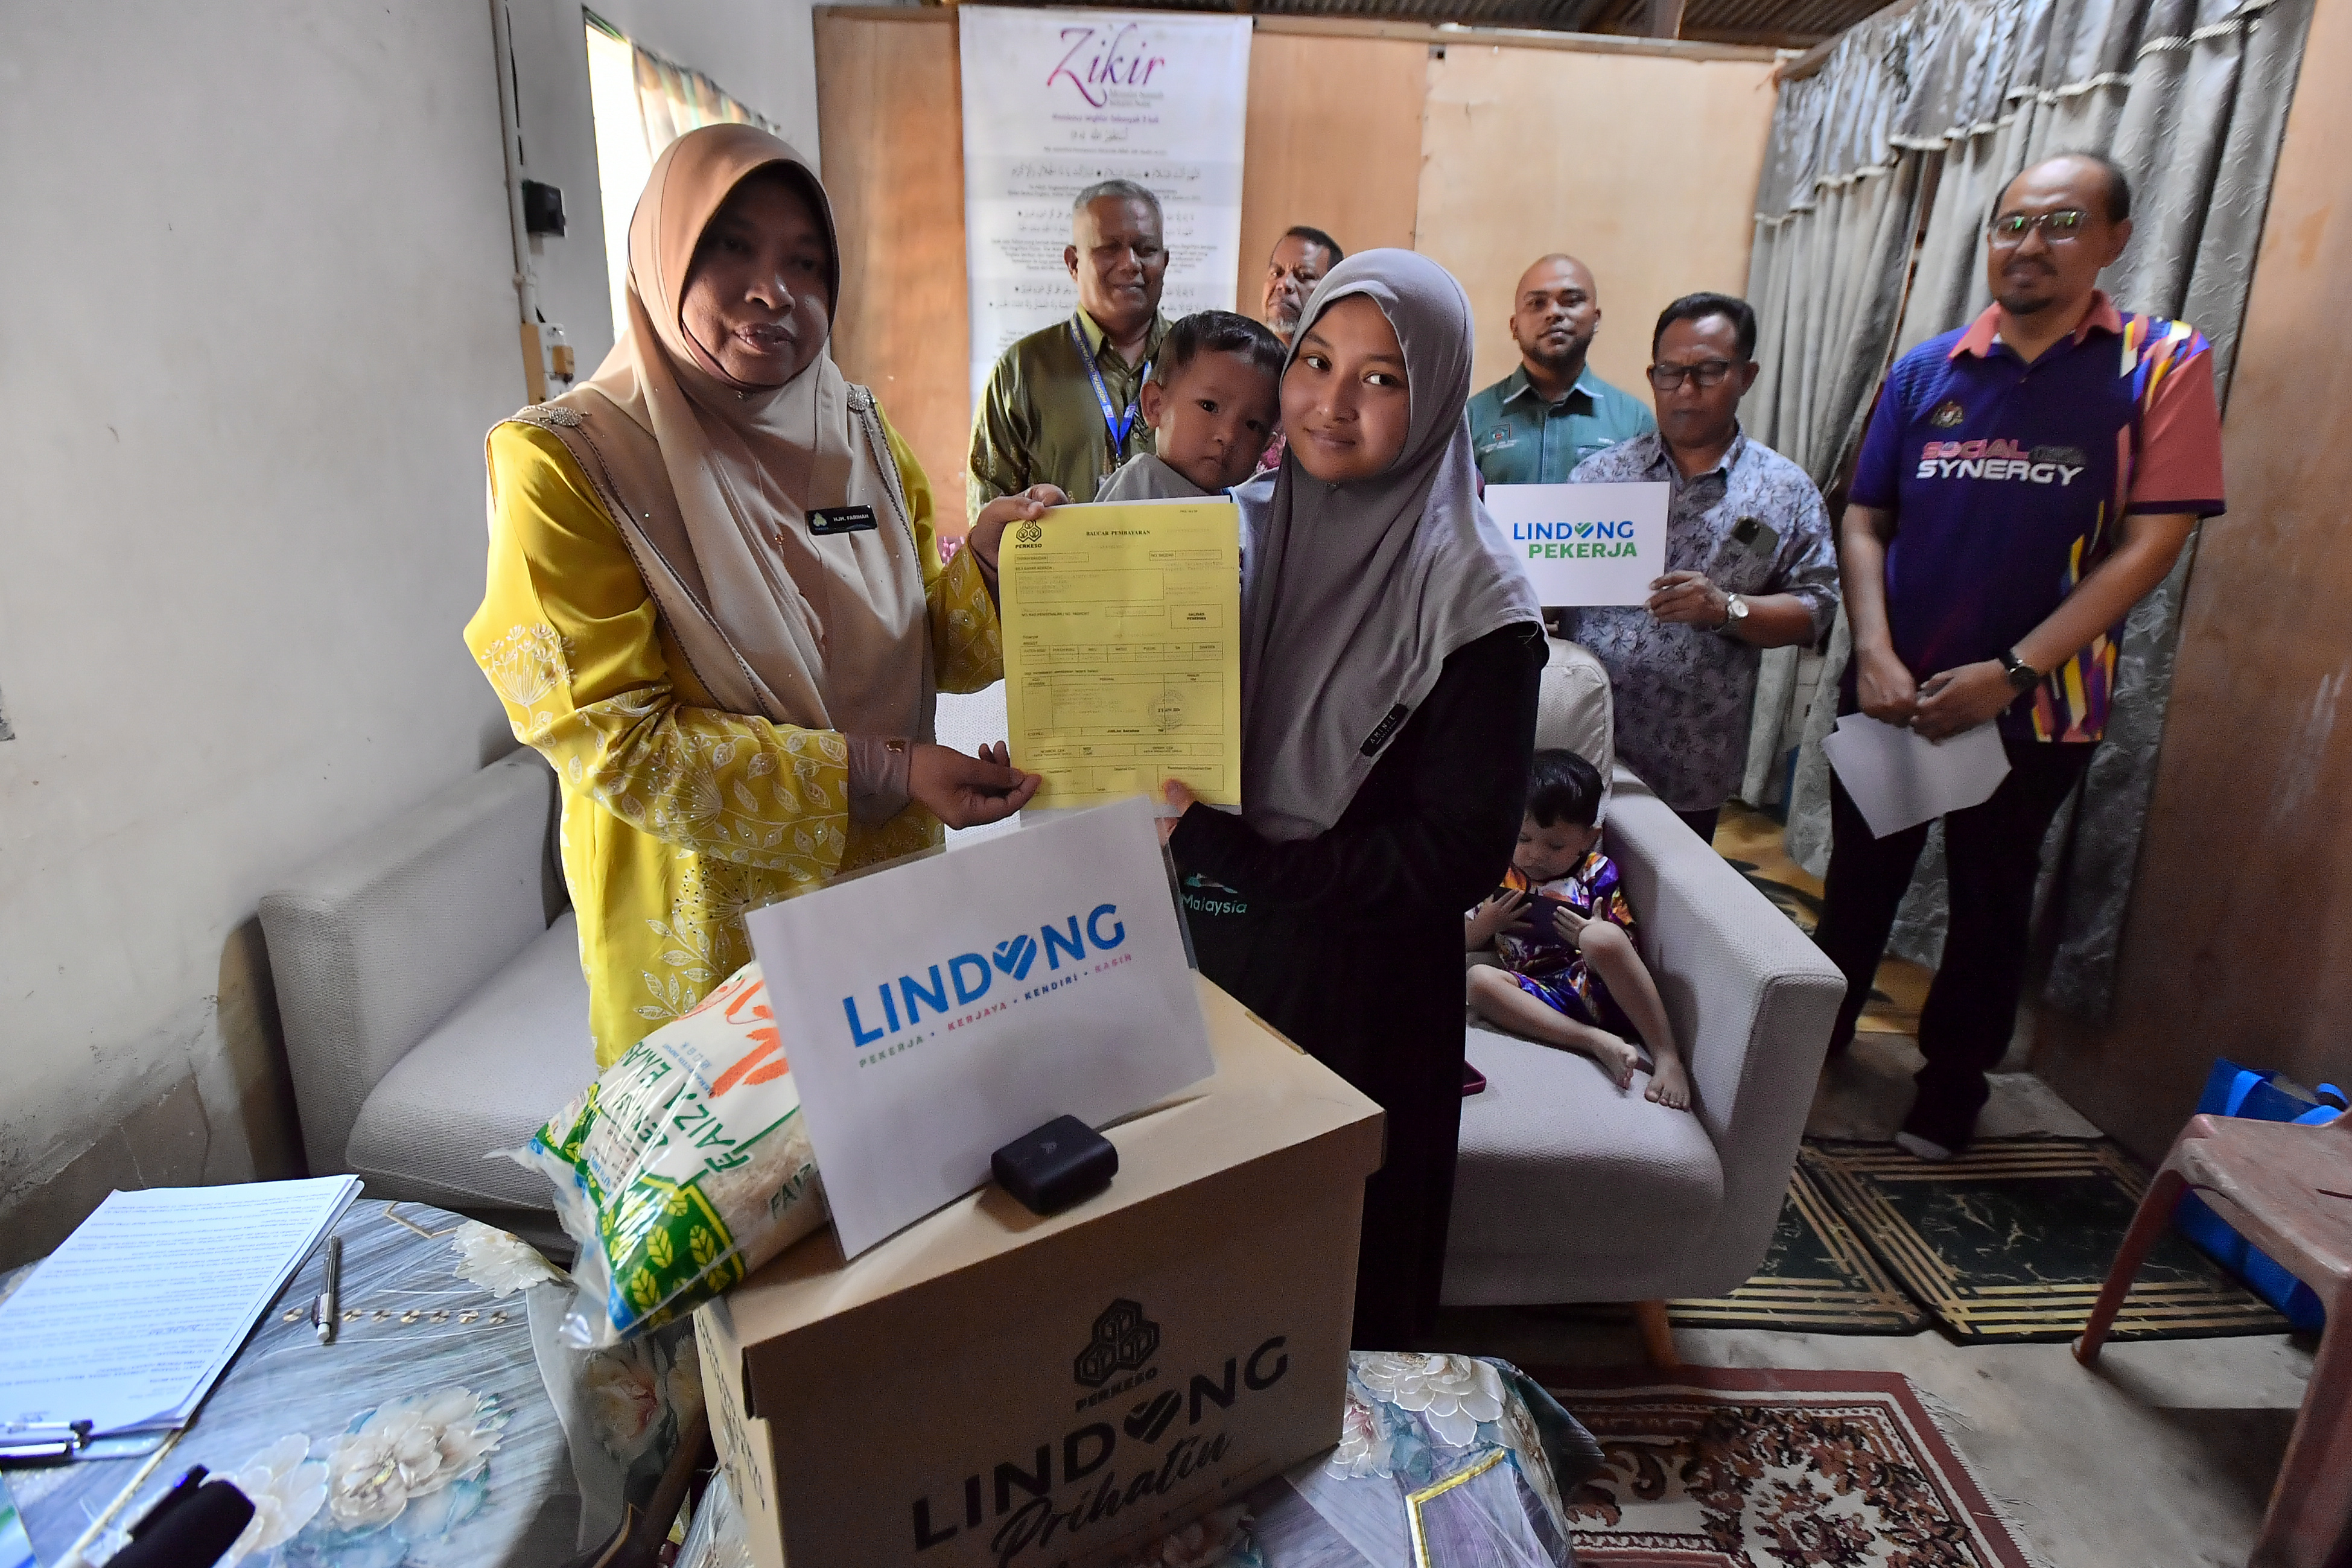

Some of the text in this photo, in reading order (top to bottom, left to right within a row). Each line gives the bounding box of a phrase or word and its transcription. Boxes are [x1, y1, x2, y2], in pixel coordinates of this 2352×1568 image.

[1047, 23, 1165, 107] Zikir
[1092, 373, 1107, 404] HOSPITAL
[1921, 438, 2029, 460] SOCIAL
[1915, 459, 2085, 486] SYNERGY
[1528, 542, 1638, 560] PEKERJA
[1180, 892, 1247, 916] Malaysia
[860, 953, 1133, 1068] PEKERJA KERJAYA KENDIRI KASIH
[621, 1041, 673, 1091] EMAS
[1075, 1366, 1157, 1413] PERKESO
[991, 1436, 1230, 1568] Prihatin
